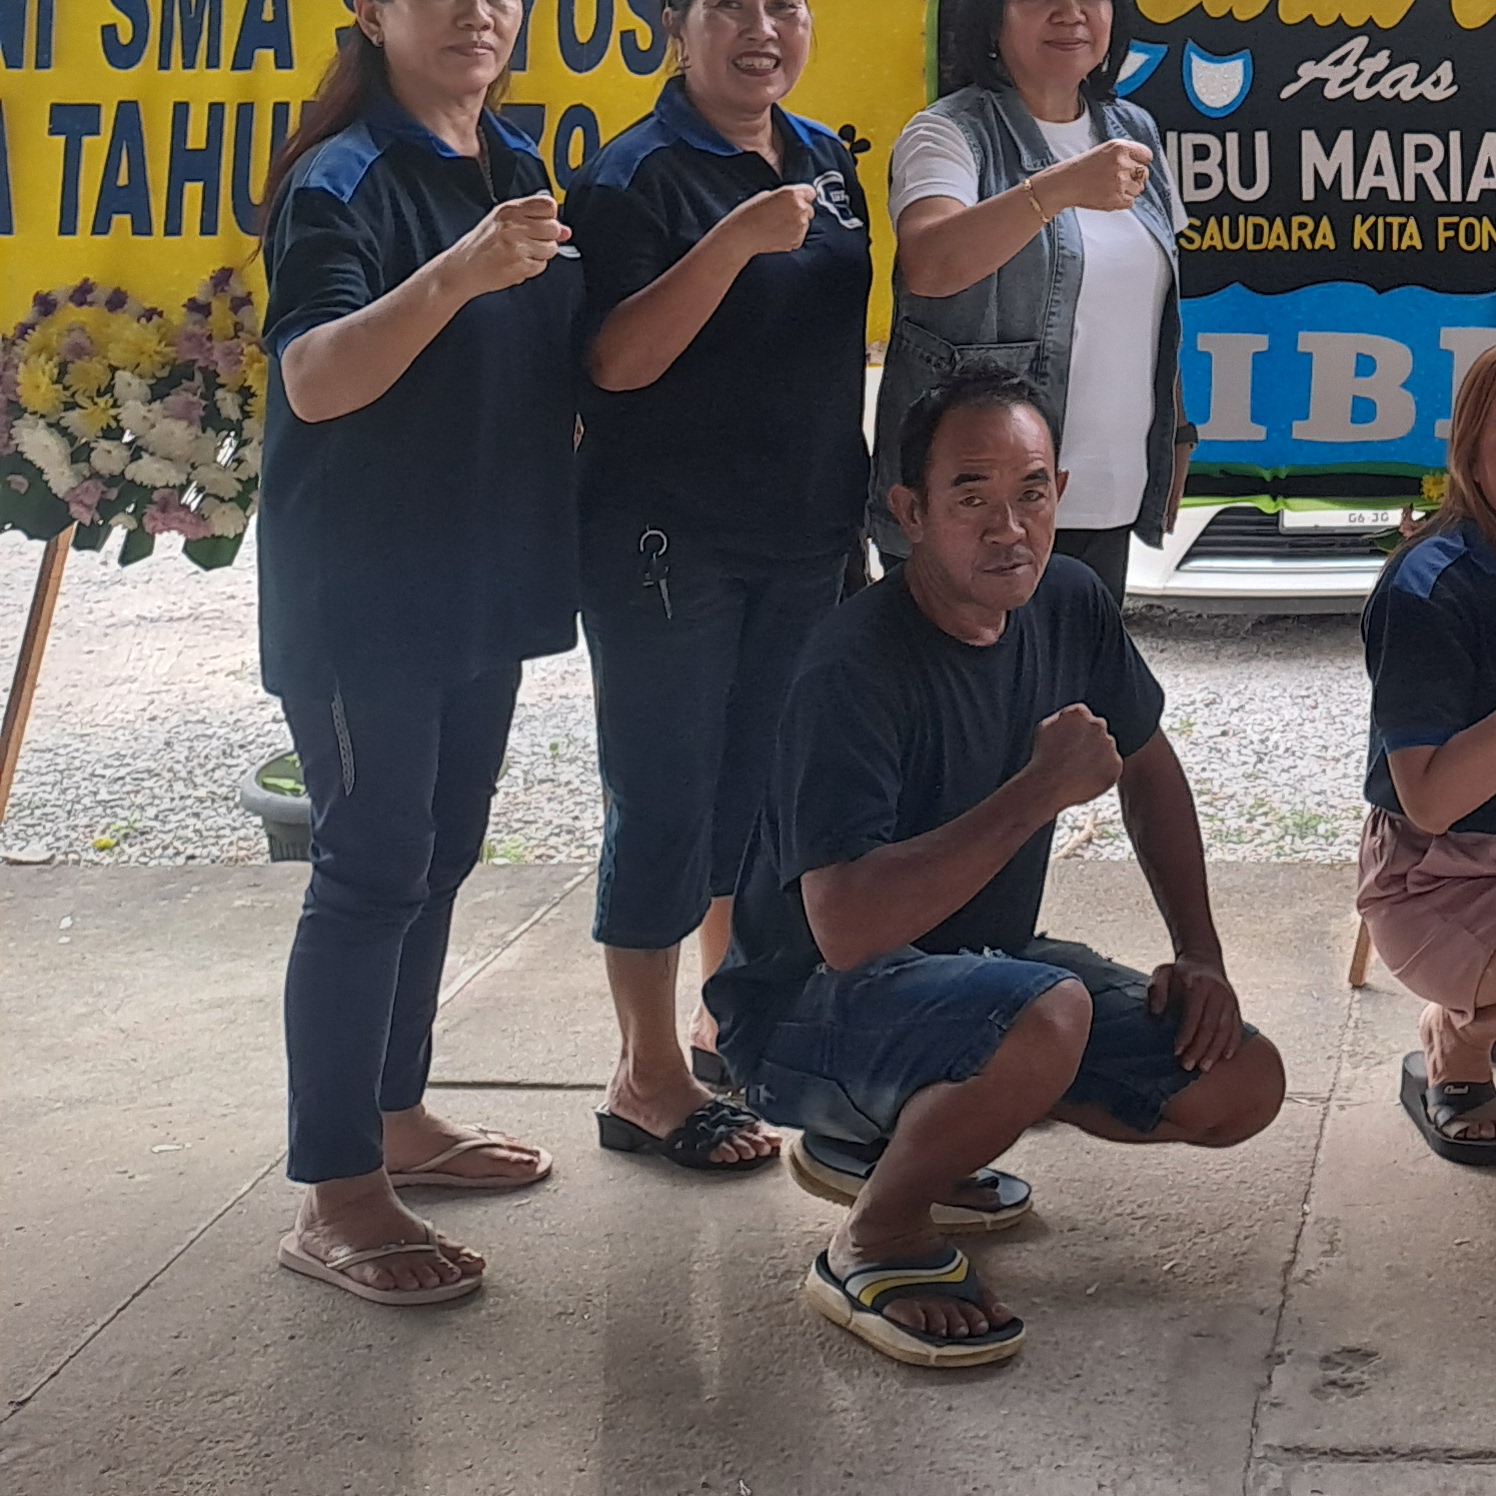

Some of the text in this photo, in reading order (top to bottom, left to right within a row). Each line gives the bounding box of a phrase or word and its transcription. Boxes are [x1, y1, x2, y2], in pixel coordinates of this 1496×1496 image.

[1280, 35, 1458, 101] Atas
[48, 100, 318, 236] TAHU
[1166, 130, 1269, 202] IBU
[1178, 214, 1335, 252] SAUDARA
[1353, 215, 1423, 251] KITA
